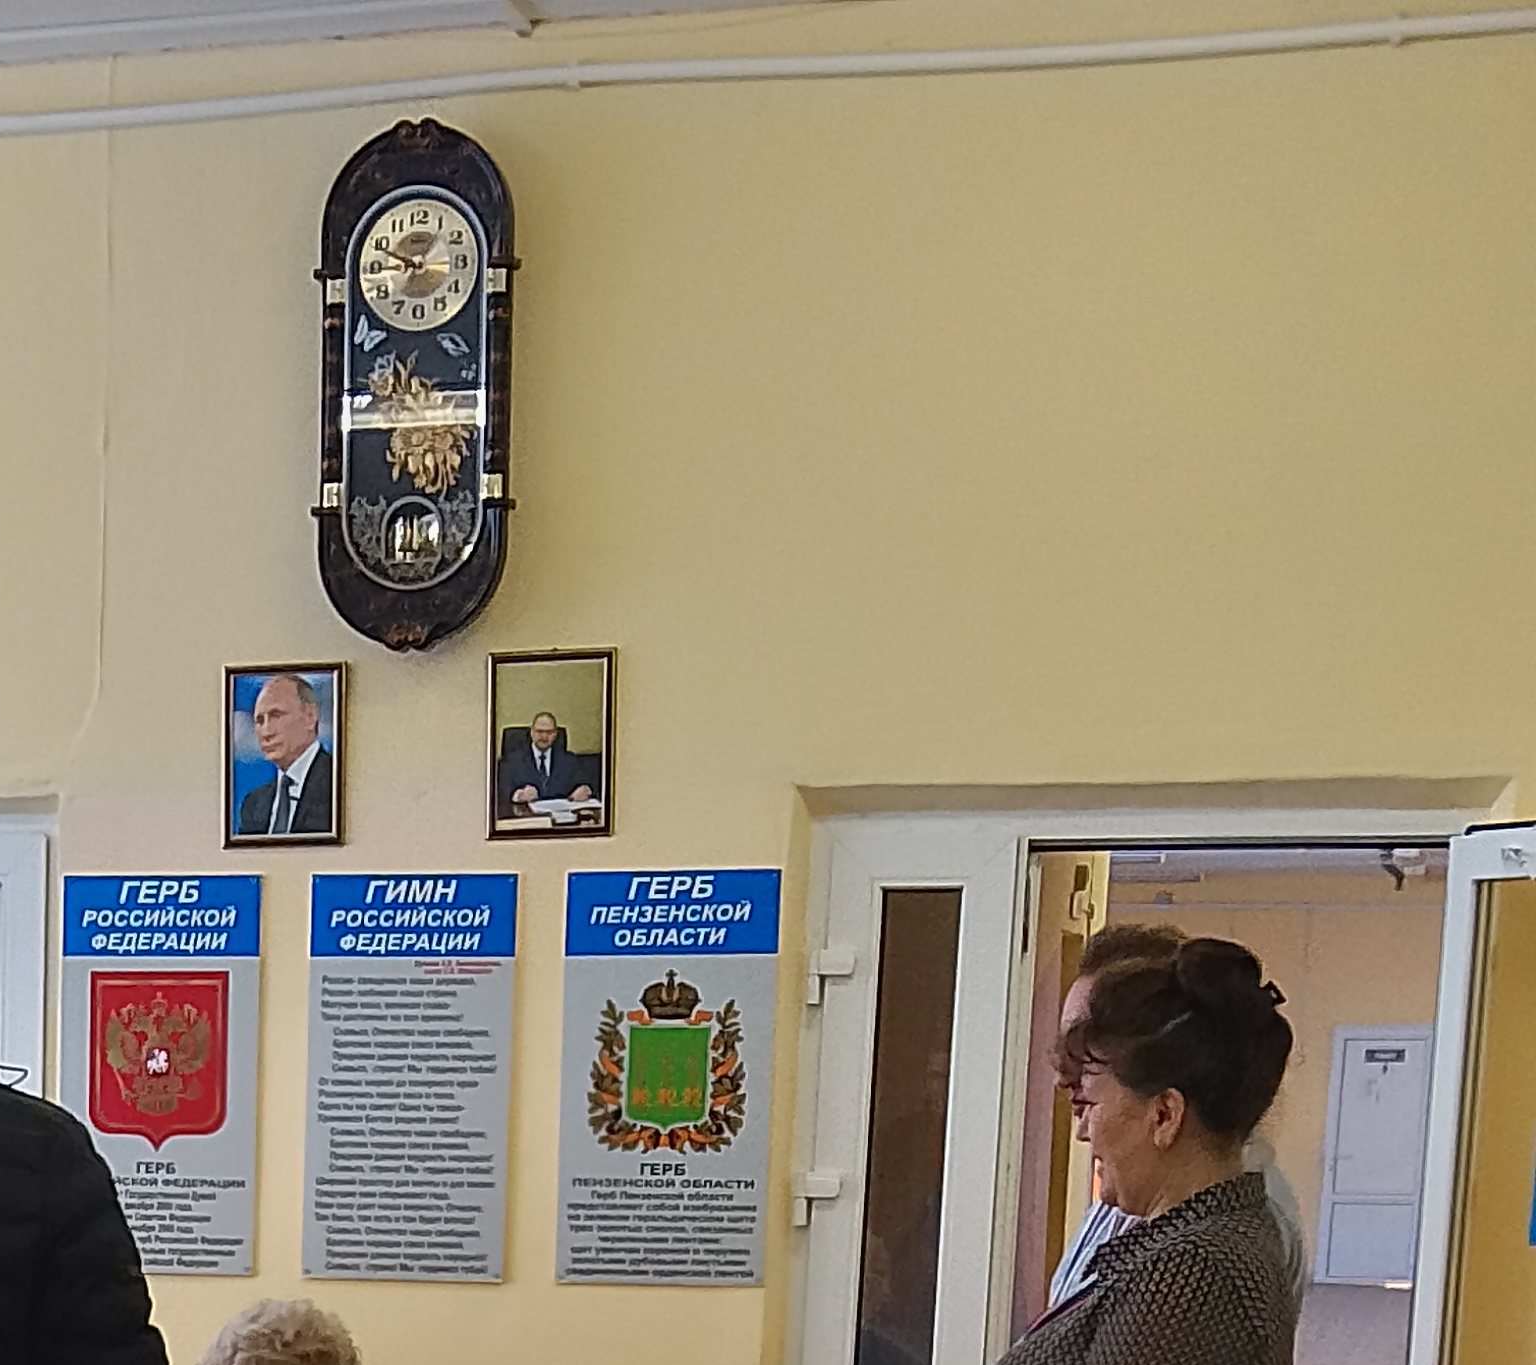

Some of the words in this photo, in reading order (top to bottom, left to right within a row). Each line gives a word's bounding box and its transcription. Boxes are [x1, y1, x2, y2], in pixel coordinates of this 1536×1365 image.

[391, 219, 404, 232] 11
[410, 210, 429, 227] 12
[375, 236, 389, 251] 10
[449, 230, 463, 245] 2
[369, 260, 382, 274] 9
[455, 254, 467, 269] 3
[376, 284, 389, 299] 8
[447, 279, 460, 294] 4
[392, 300, 405, 315] 7
[433, 296, 447, 311] 5
[412, 304, 425, 319] 6
[119, 880, 200, 904] ГЕРБ
[365, 879, 457, 904] ГИМН
[627, 875, 714, 900] ГЕРБ
[82, 905, 237, 927] РОССИЙСКОЙ
[330, 904, 491, 927] РОССИЙСКОЙ
[590, 900, 752, 924] ПЕНЗЕНСКОЙ
[91, 932, 227, 954] ФЕДЕРАЦИИ
[339, 932, 481, 954] ФЕДЕРАЦИИ
[614, 927, 727, 947] ОБЛАСТИ
[136, 1162, 176, 1175] ГЕРБ
[640, 1163, 686, 1176] ГЕРБ
[161, 1178, 246, 1189] ФЕДЕРАЦИИ
[572, 1178, 676, 1188] ПЕНЗЕНСКОЙ
[680, 1179, 755, 1190] ОБЛАСТИ
